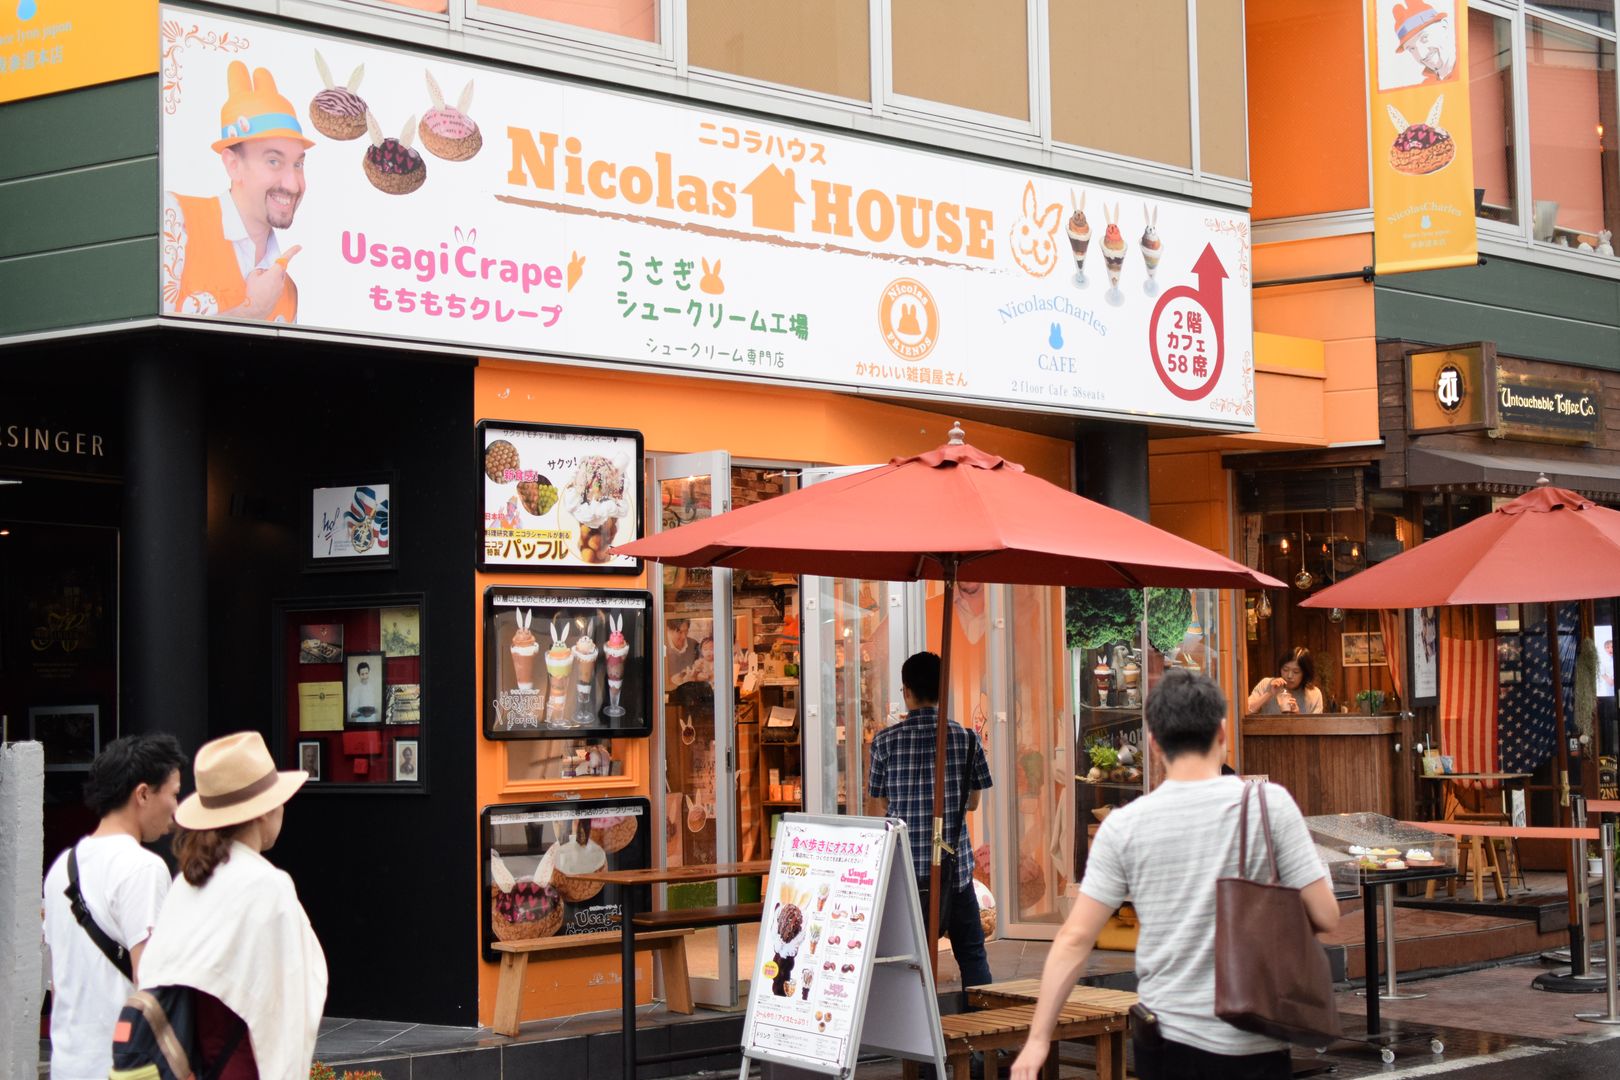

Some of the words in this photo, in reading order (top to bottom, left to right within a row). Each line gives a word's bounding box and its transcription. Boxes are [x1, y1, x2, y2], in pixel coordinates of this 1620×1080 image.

[699, 122, 827, 165] ニコラハウス
[507, 126, 737, 218] Nicolas
[812, 179, 995, 260] HOUSE
[617, 250, 695, 291] うさぎ
[369, 285, 563, 328] もちもちクレープ
[617, 291, 809, 341] シュークリーム工場
[997, 294, 1108, 337] NicolasCharles
[1173, 310, 1202, 334] 2階
[645, 338, 785, 368] シュークリーム専門店
[1167, 332, 1206, 352] カフェ
[855, 361, 969, 388] かわいい雑貨屋さん
[1038, 354, 1078, 374] CAFE
[1167, 353, 1208, 378] 58席
[1502, 387, 1555, 412] Untouchable
[1554, 393, 1580, 415] Toffee
[0, 425, 104, 456] SINGER
[503, 538, 569, 560] パッフル
